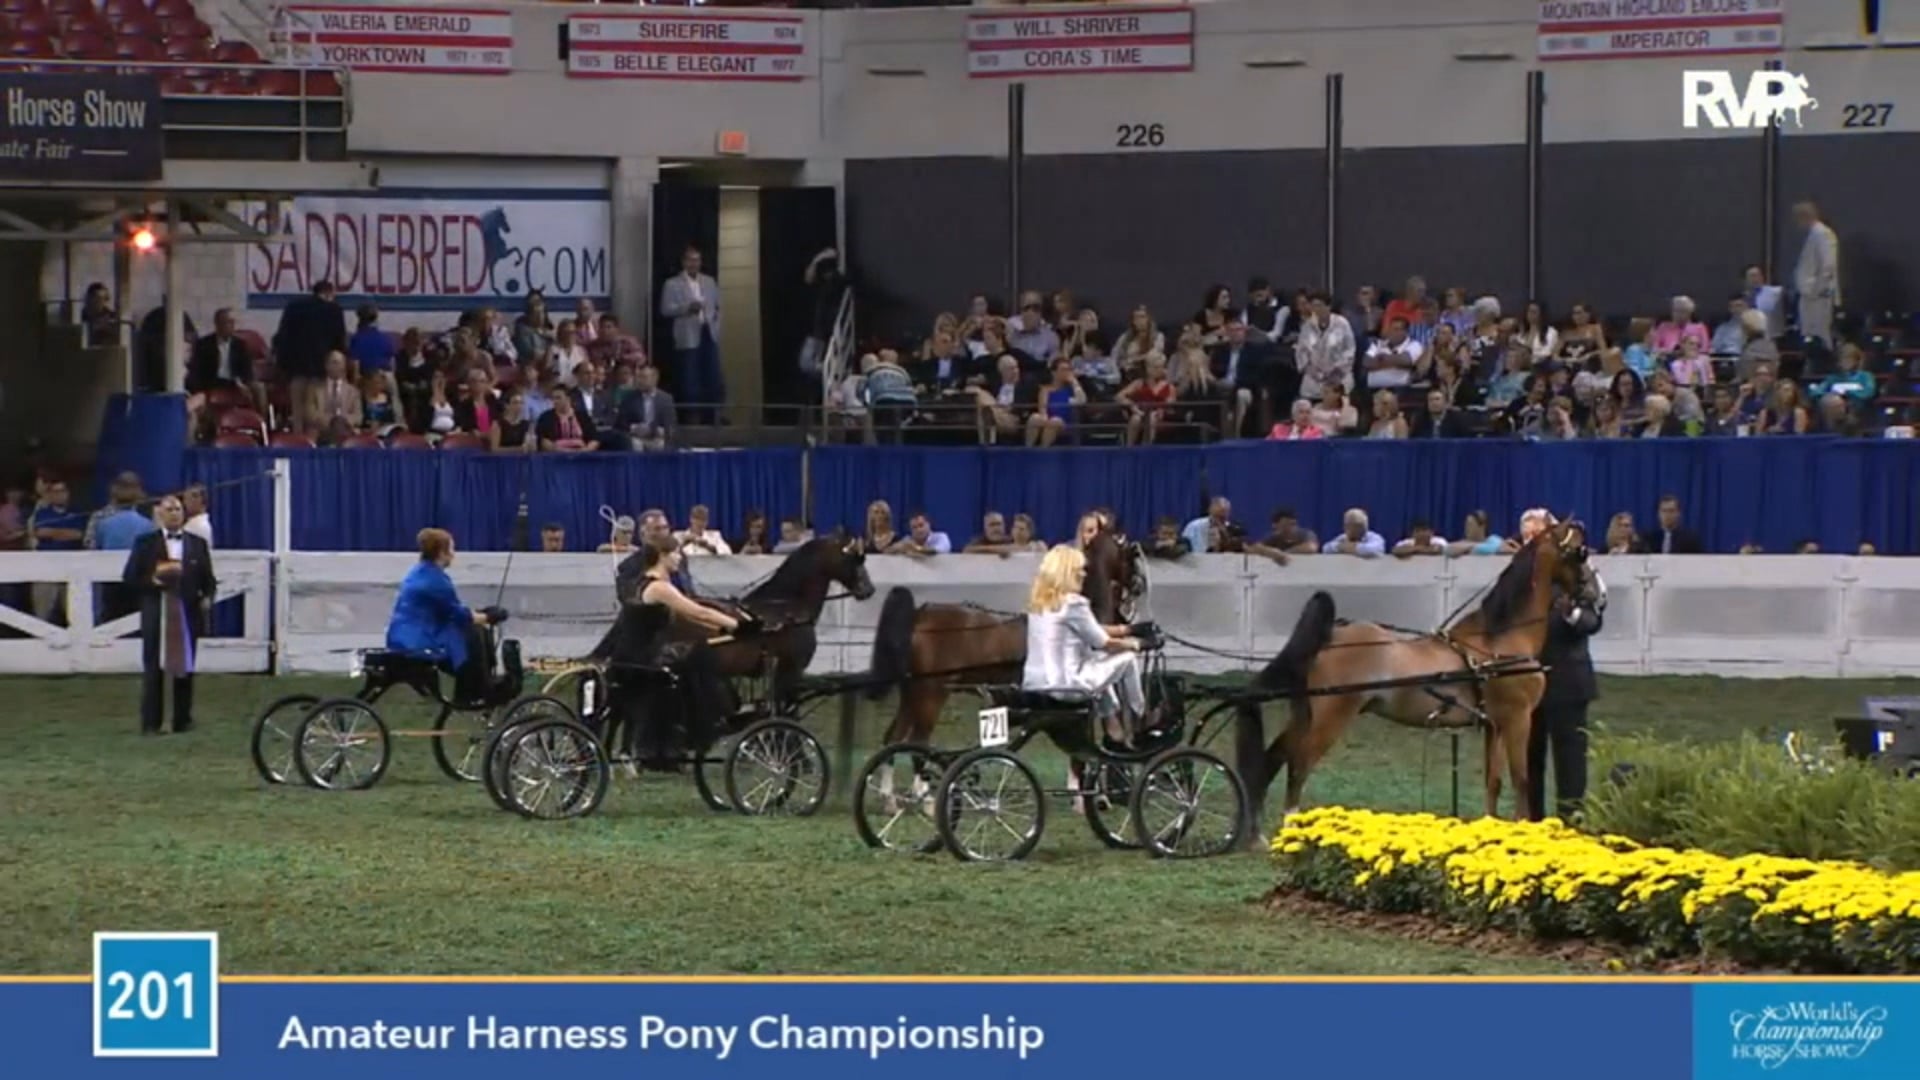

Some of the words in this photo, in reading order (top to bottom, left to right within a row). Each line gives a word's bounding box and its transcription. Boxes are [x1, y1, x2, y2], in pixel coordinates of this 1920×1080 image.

[321, 14, 387, 31] VALERIA
[393, 15, 471, 32] EMERALD
[639, 22, 730, 39] SUREFIRE
[1014, 20, 1054, 36] WILL
[1064, 17, 1140, 35] SHRIVER
[1611, 31, 1710, 48] IMPERATOR
[322, 46, 425, 64] YORKTOWN
[613, 54, 667, 70] BELLE
[677, 56, 757, 73] ELEGANT
[1024, 50, 1092, 66] CORA'S
[1103, 48, 1142, 64] TIME
[8, 88, 76, 126] Horse
[84, 89, 146, 128] Show
[1842, 103, 1893, 127] 227
[1116, 123, 1165, 147] 226
[34, 138, 74, 159] Fair
[980, 713, 1005, 740] 721
